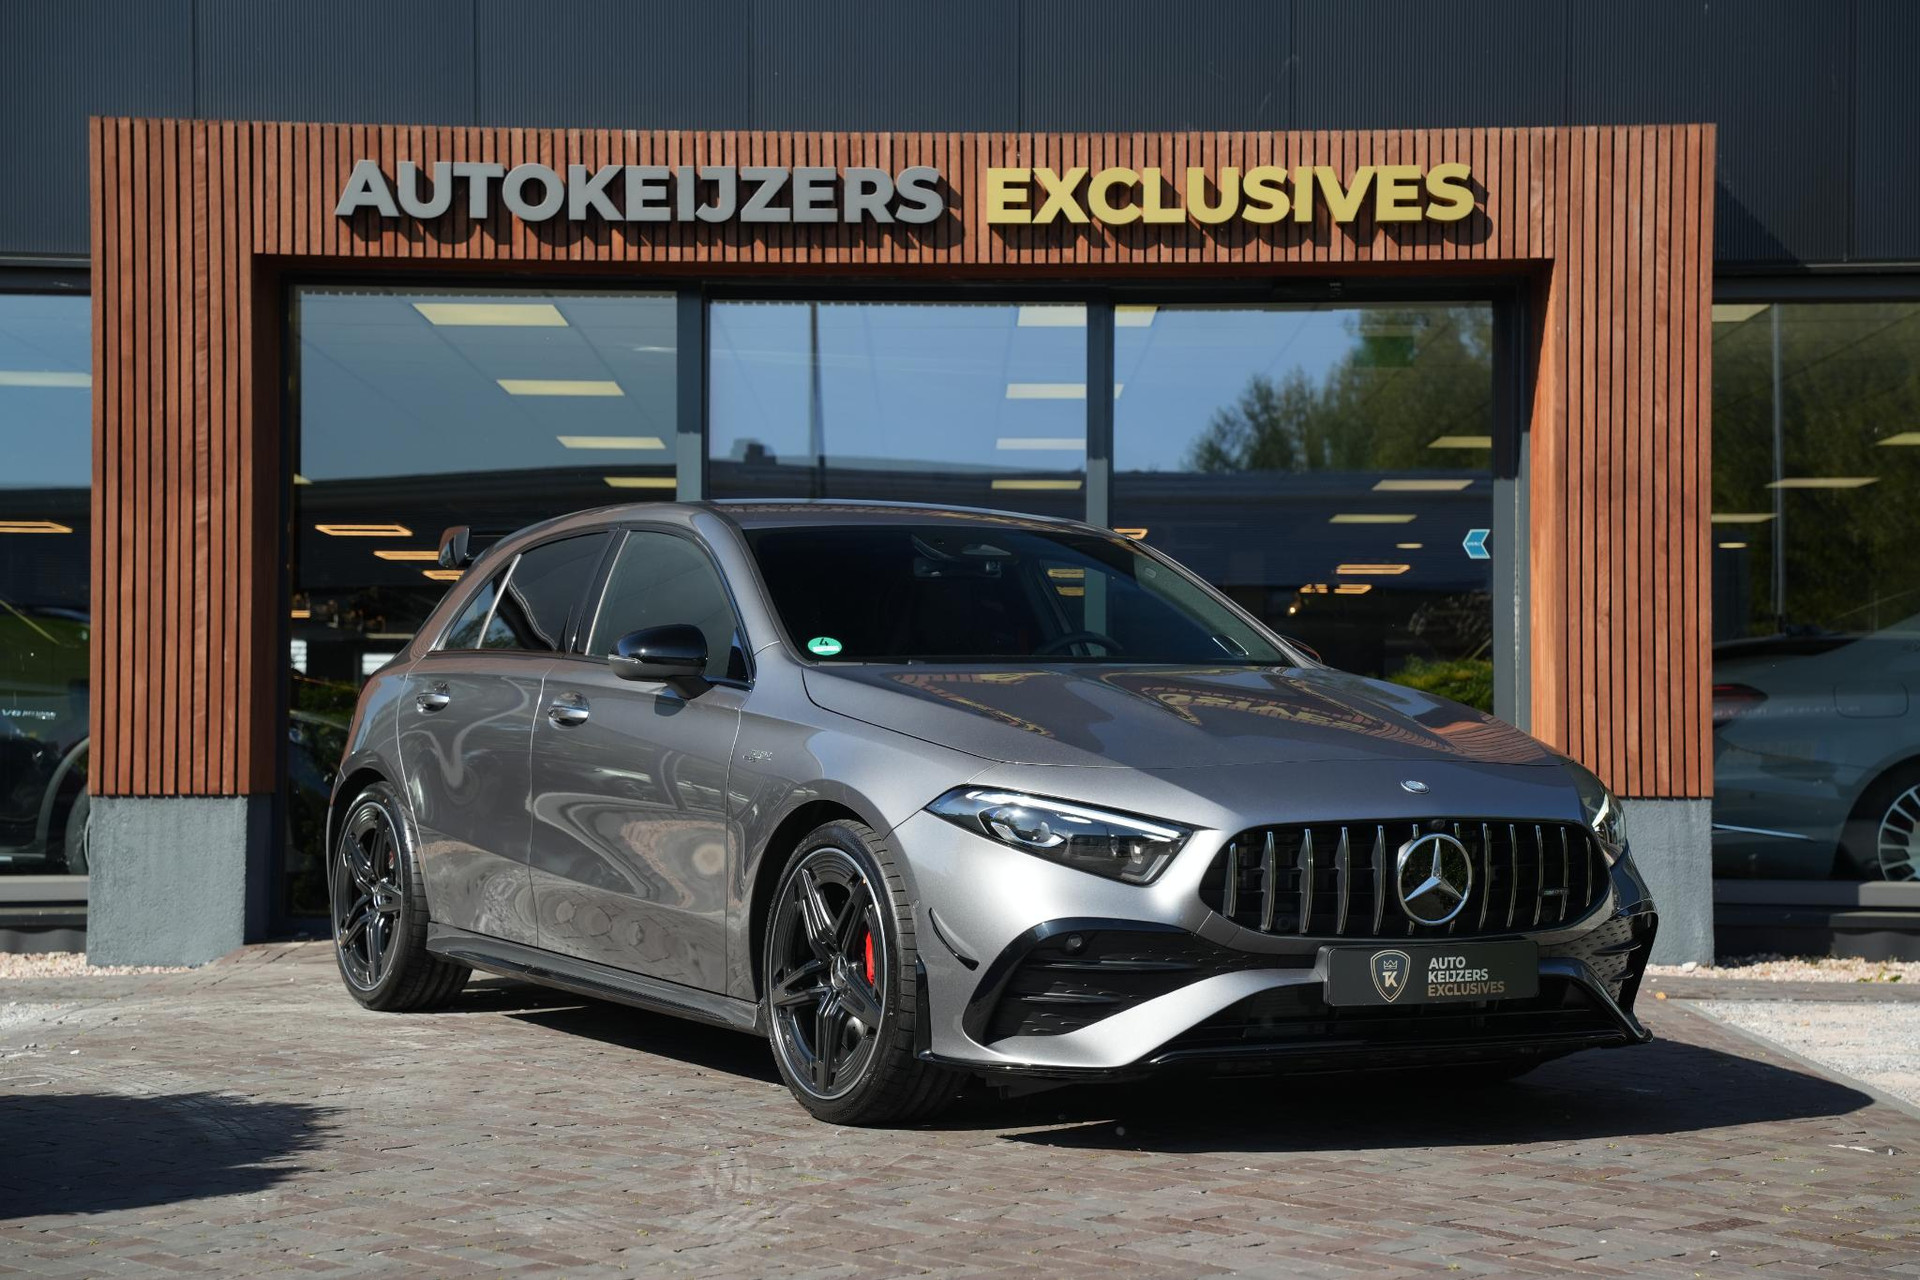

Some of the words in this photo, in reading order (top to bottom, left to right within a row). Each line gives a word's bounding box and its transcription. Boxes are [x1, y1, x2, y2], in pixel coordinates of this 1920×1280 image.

[334, 159, 945, 224] AUTOKEIJZERS
[986, 163, 1475, 226] EXCLUSIVES
[1428, 956, 1466, 970] AUTO
[1427, 968, 1489, 984] KEIJZERS
[1427, 981, 1505, 997] EXCLUSIVES
